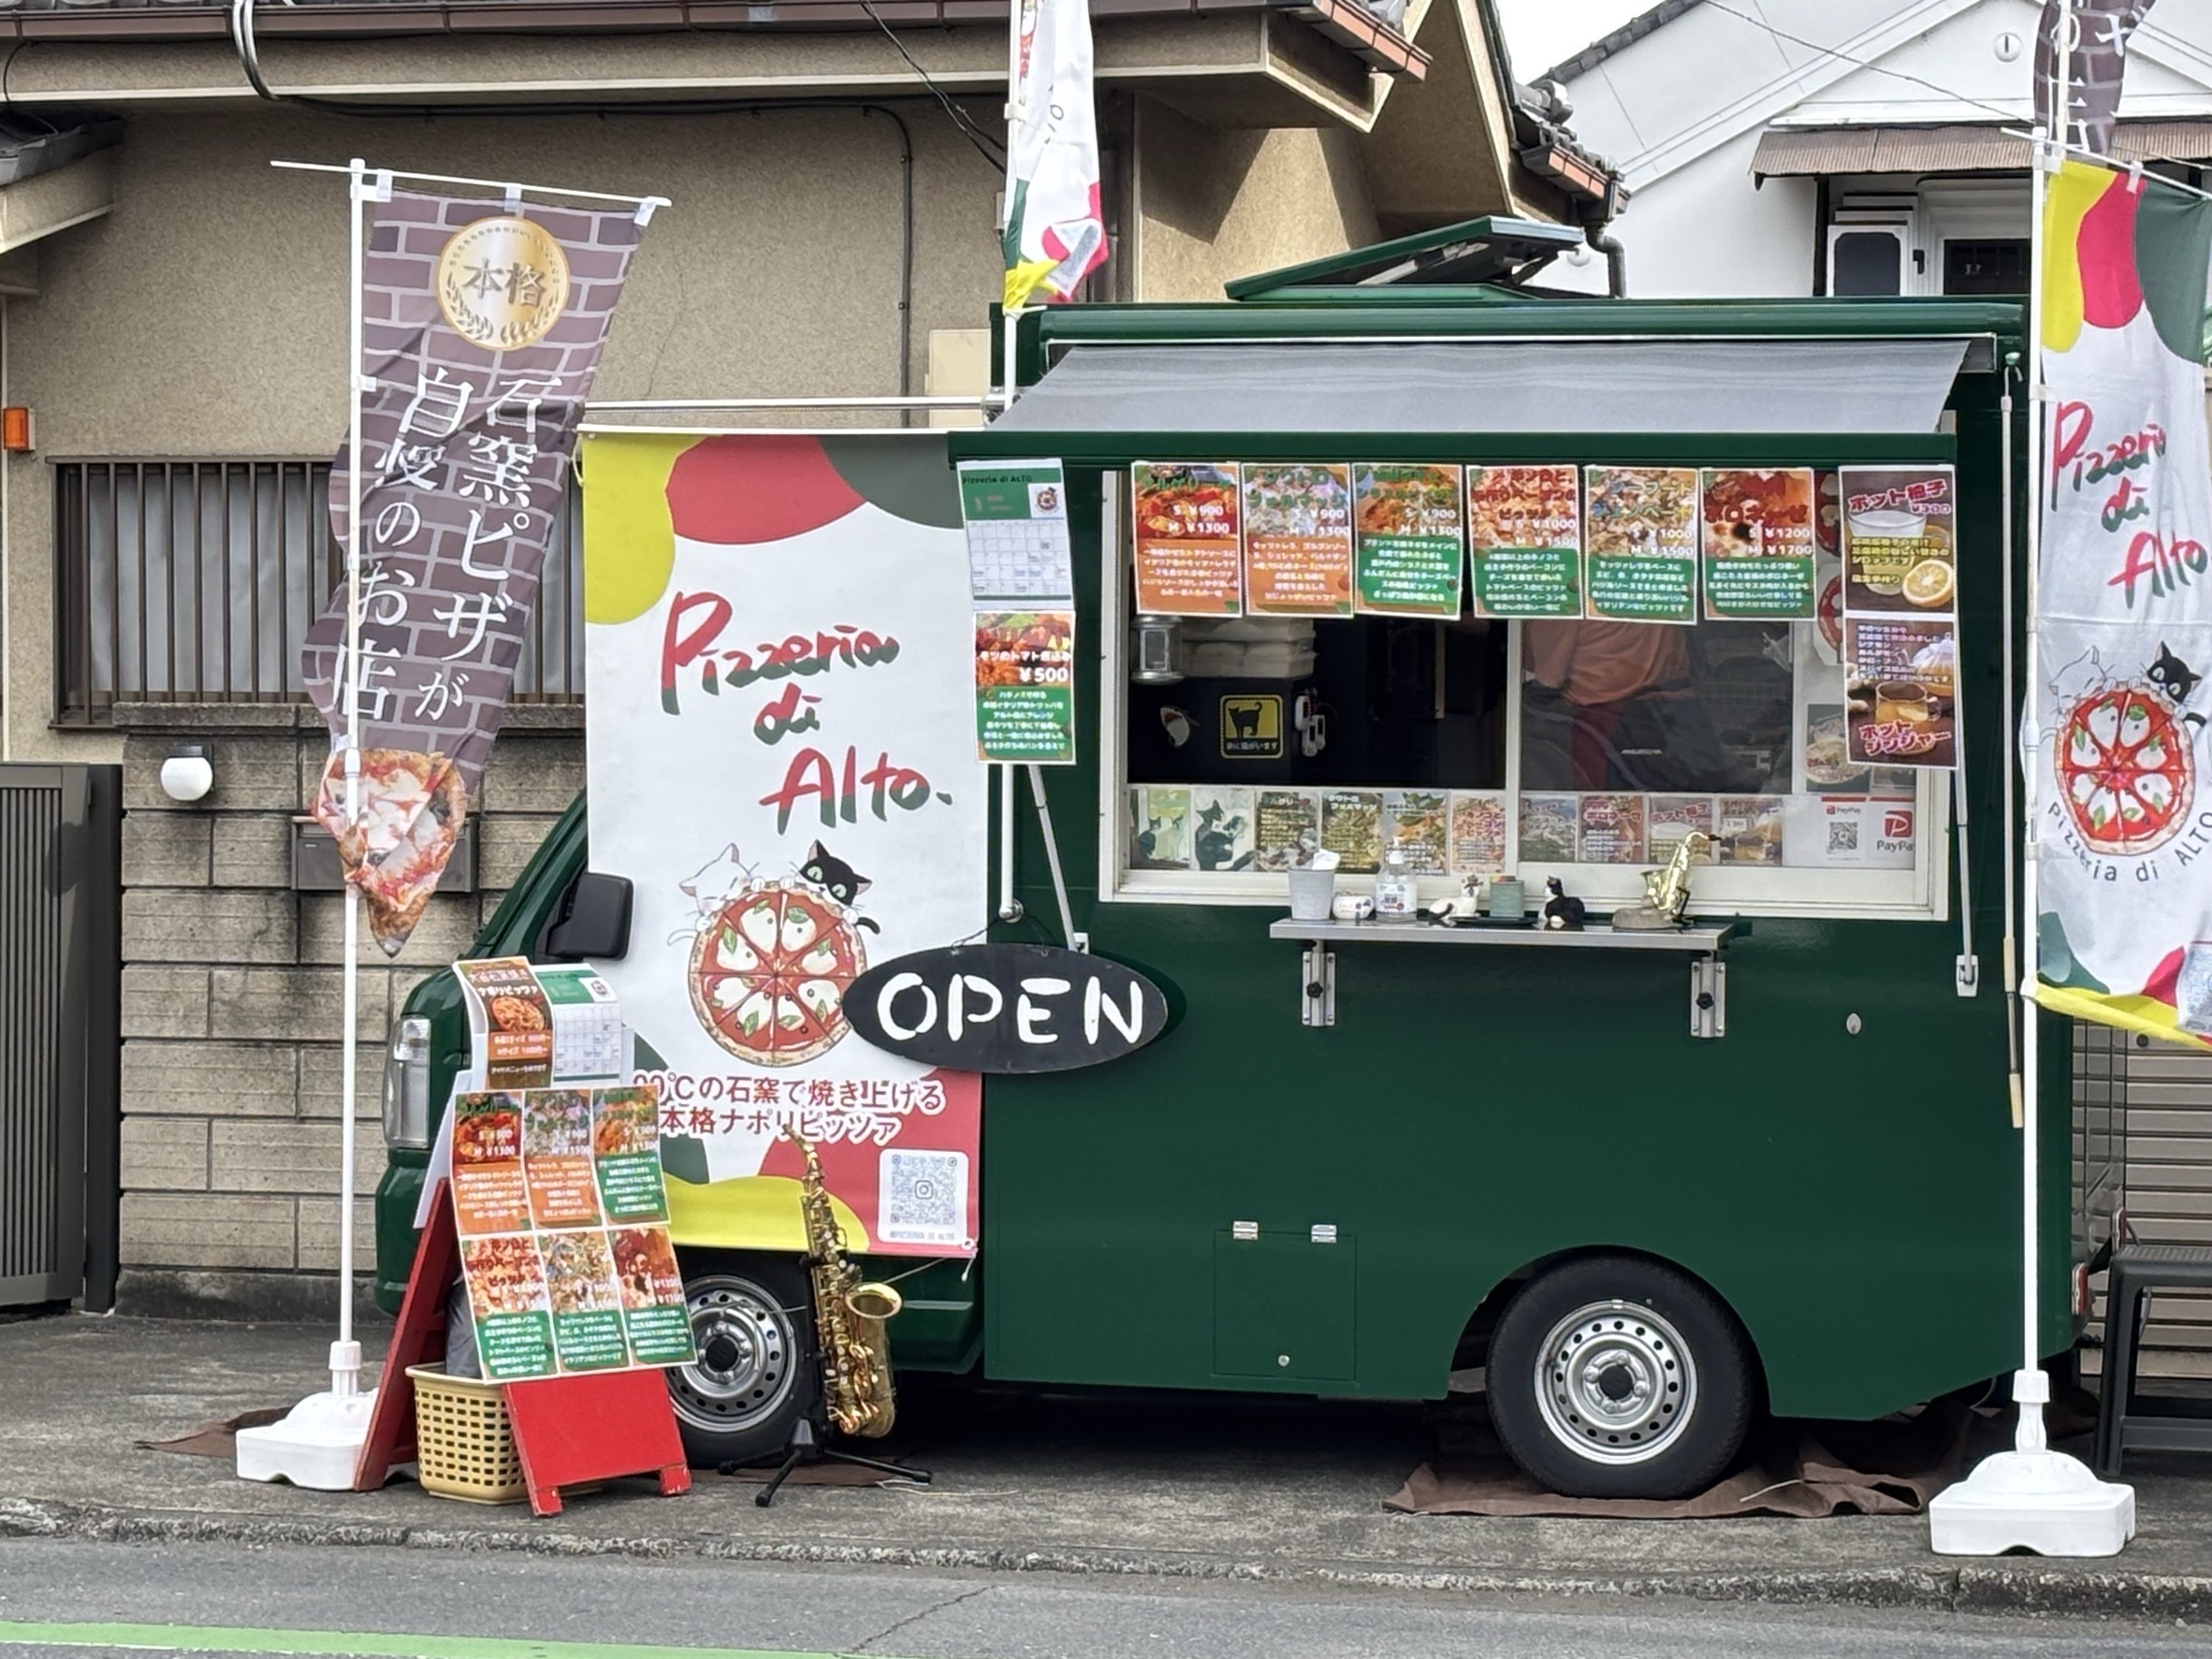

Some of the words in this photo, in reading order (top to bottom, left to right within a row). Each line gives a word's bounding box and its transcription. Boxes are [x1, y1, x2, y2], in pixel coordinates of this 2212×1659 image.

[461, 257, 546, 309] 本格
[999, 474, 1009, 483] di
[1011, 473, 1033, 483] ALTO
[2101, 476, 2150, 532] di
[1172, 505, 1182, 516] S
[1189, 505, 1224, 517] ¥900
[1310, 509, 1345, 519] ¥900
[1420, 509, 1456, 519] ¥900
[1168, 523, 1179, 532] M
[1186, 523, 1230, 533] ¥1300
[1532, 519, 1576, 529] ¥1000
[1649, 529, 1693, 539] ¥1000
[1765, 527, 1811, 537] ¥1200
[333, 367, 473, 720] 自慢のお店
[1534, 537, 1578, 546] ¥1500
[415, 374, 563, 722] 石窯ピザが
[1631, 545, 1641, 553] M
[1650, 546, 1694, 555] ¥1500
[1767, 546, 1812, 555] ¥1700
[662, 590, 900, 715] Pizzeria
[1019, 666, 1069, 683] ¥500
[753, 682, 822, 745] di
[1836, 807, 1861, 816] PayPay
[1876, 839, 1915, 852] PayPa
[2135, 860, 2159, 882] di
[2175, 811, 2212, 867] ALTO
[877, 972, 1143, 1045] OPEN
[633, 1072, 942, 1111] ℃の石窯で焼き上げる
[660, 1105, 898, 1142] 本格ナポリピッツァ
